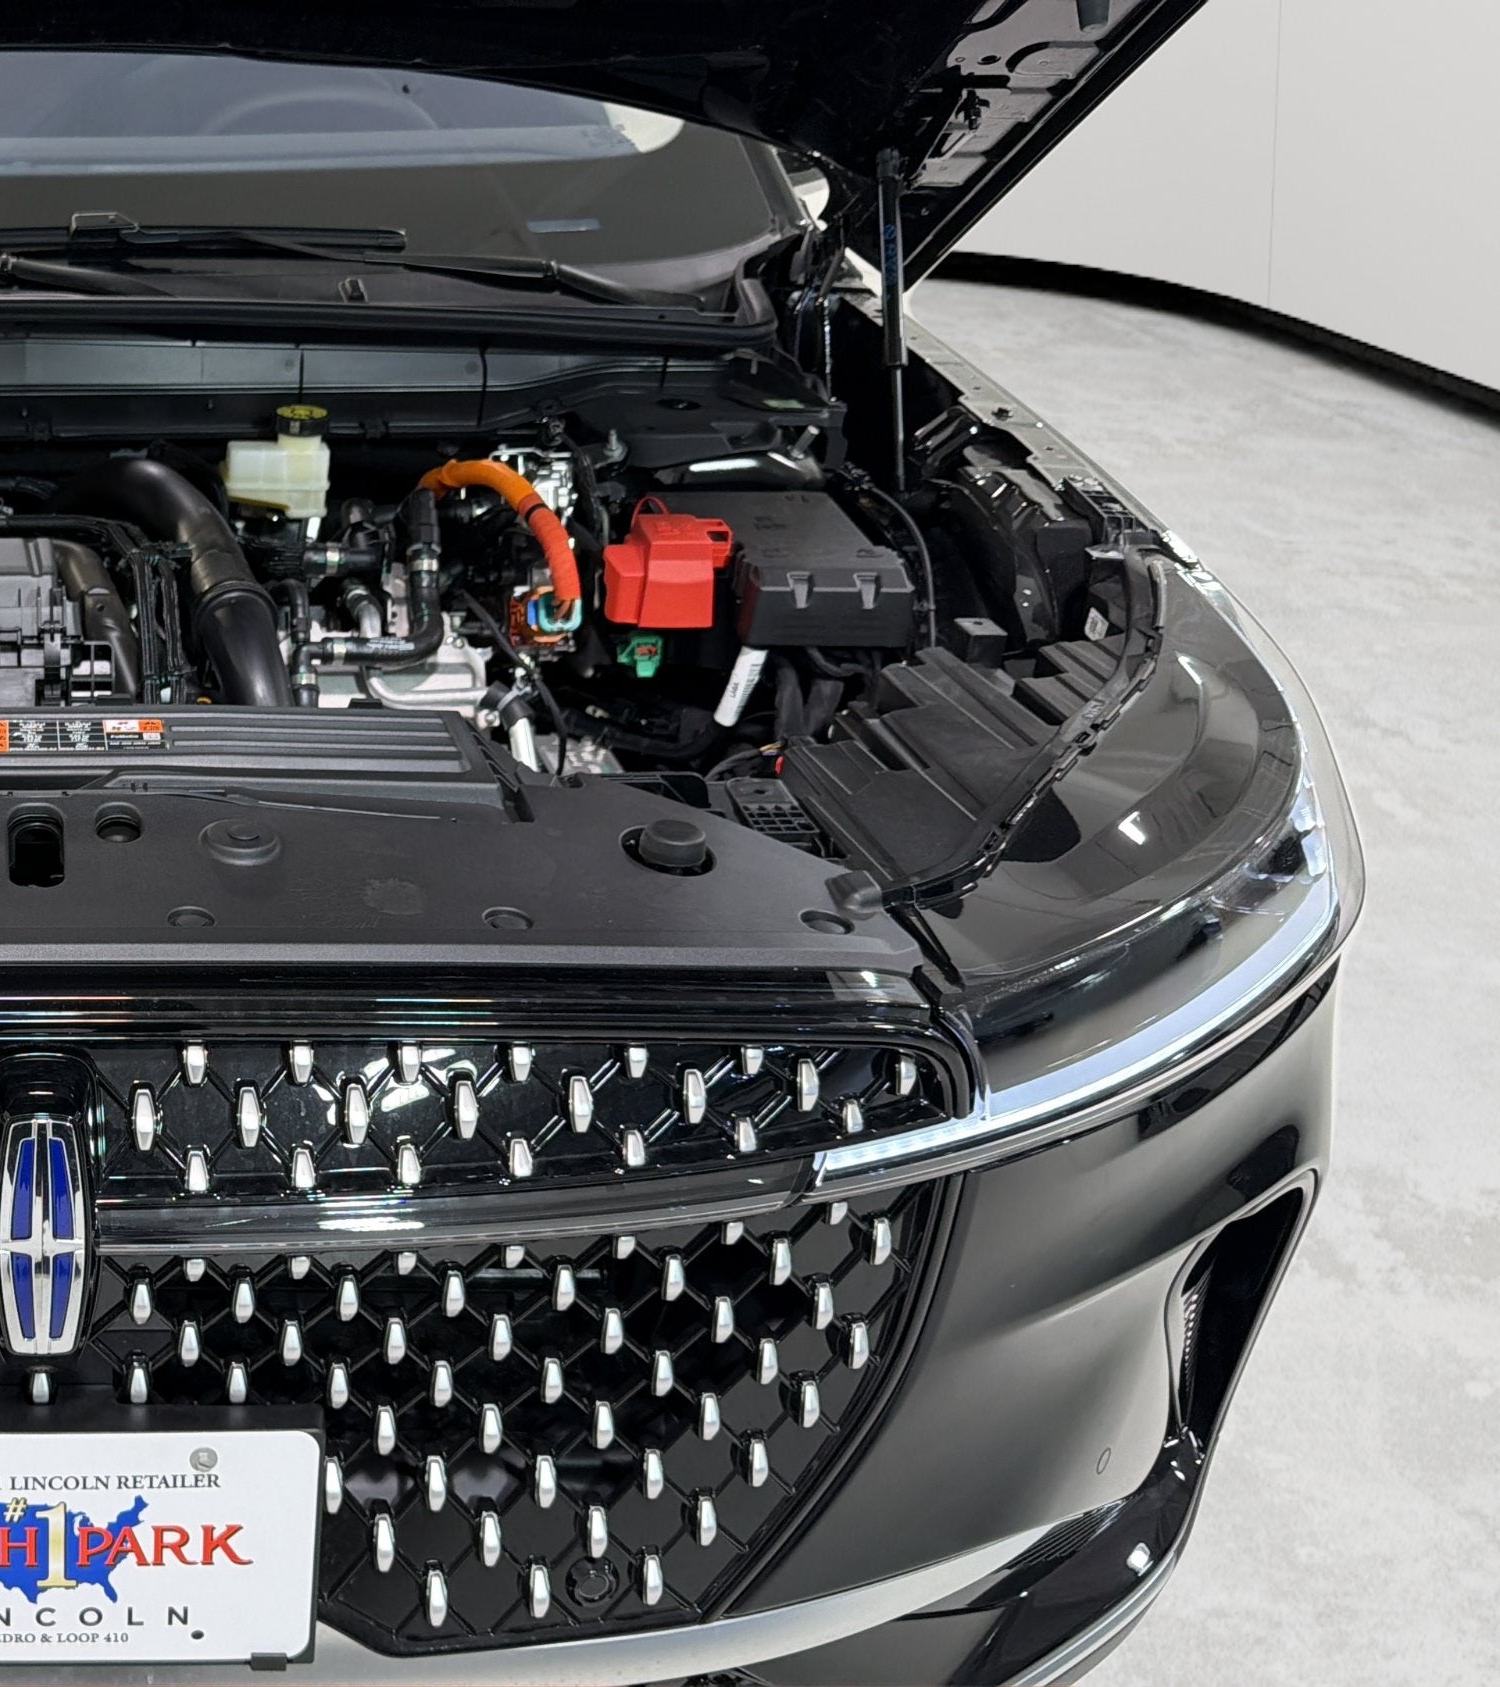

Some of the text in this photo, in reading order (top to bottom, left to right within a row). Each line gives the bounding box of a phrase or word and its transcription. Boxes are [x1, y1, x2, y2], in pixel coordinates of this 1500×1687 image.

[10, 1474, 111, 1491] LINCOLN
[116, 1473, 221, 1489] RETAILER
[77, 1523, 254, 1568] PARK
[40, 1631, 53, 1644] &
[56, 1632, 100, 1644] LOOP
[103, 1631, 129, 1644] 410
